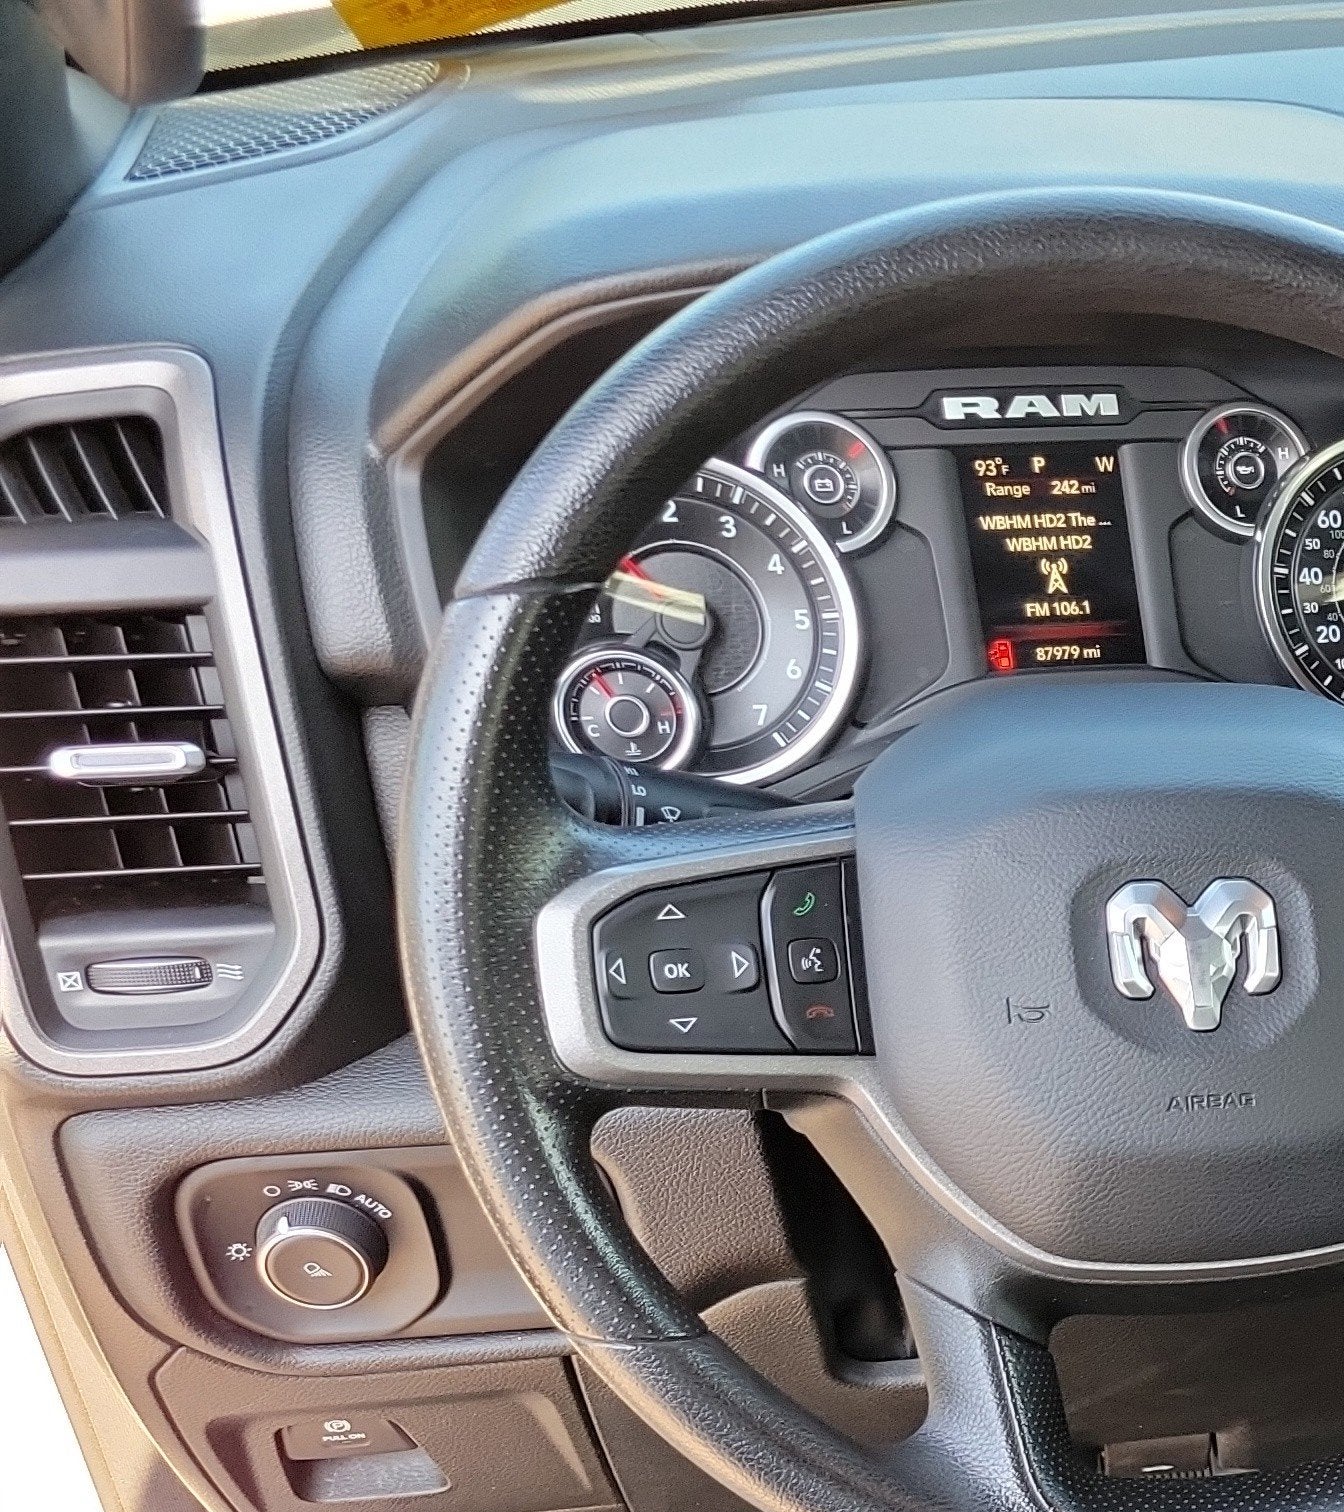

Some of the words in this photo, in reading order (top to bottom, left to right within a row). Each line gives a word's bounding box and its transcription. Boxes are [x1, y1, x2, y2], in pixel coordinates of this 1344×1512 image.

[943, 393, 1119, 420] RAM
[1277, 447, 1289, 460] H
[772, 463, 786, 478] H
[1032, 456, 1045, 473] P
[1095, 455, 1114, 473] W
[985, 482, 1031, 498] Range
[1050, 480, 1080, 495] 242
[1081, 482, 1096, 493] mi
[662, 500, 679, 522] 2
[1235, 505, 1246, 518] L
[1317, 510, 1342, 528] 60
[720, 515, 737, 538] 3
[841, 521, 853, 534] L
[979, 514, 1031, 530] WBHM
[1033, 513, 1066, 528] HD2
[1066, 512, 1096, 527] The
[1006, 536, 1057, 552] WBHM
[1059, 535, 1093, 550] HD2
[1305, 538, 1321, 550] 50
[767, 553, 785, 575] 4
[1300, 567, 1323, 585] 40
[1319, 584, 1331, 593] 60
[1025, 602, 1050, 617] FM
[1053, 600, 1091, 615] 106.1
[1303, 602, 1319, 614] 30
[1326, 612, 1338, 622] 40
[794, 609, 810, 630] 5
[1316, 624, 1341, 643] 20
[1036, 646, 1080, 661] 87979
[1083, 645, 1101, 659] mi
[786, 658, 802, 679] 6
[752, 704, 768, 726] 7
[587, 724, 600, 738] C
[657, 720, 671, 734] H
[664, 963, 690, 979] OK
[1165, 1092, 1256, 1112] AIRBAG
[354, 1194, 393, 1219] AUTO
